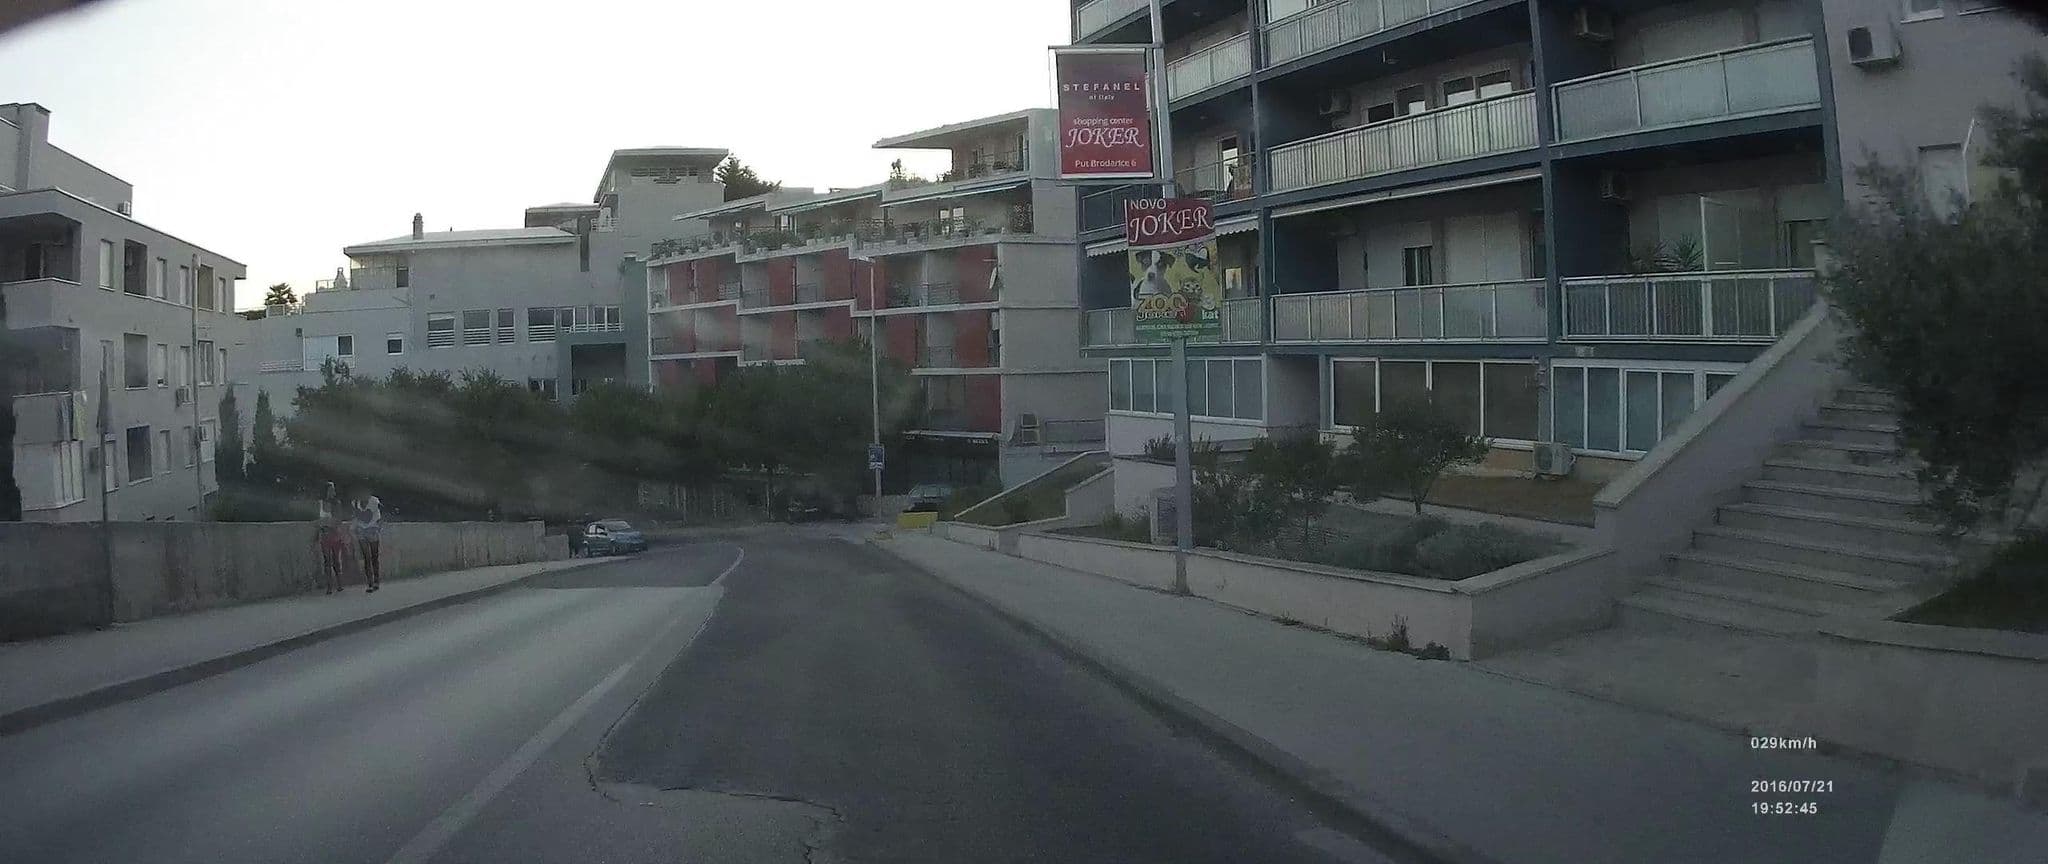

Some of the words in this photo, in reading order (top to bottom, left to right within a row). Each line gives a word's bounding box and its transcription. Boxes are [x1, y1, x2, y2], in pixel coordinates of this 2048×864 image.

[1063, 83, 1141, 92] STEFANEL
[1073, 117, 1109, 127] shopping
[1065, 127, 1145, 148] JOKER
[1075, 159, 1090, 168] Put
[1130, 159, 1137, 167] 6
[1129, 199, 1167, 211] NOVO
[1129, 206, 1216, 243] JOKER
